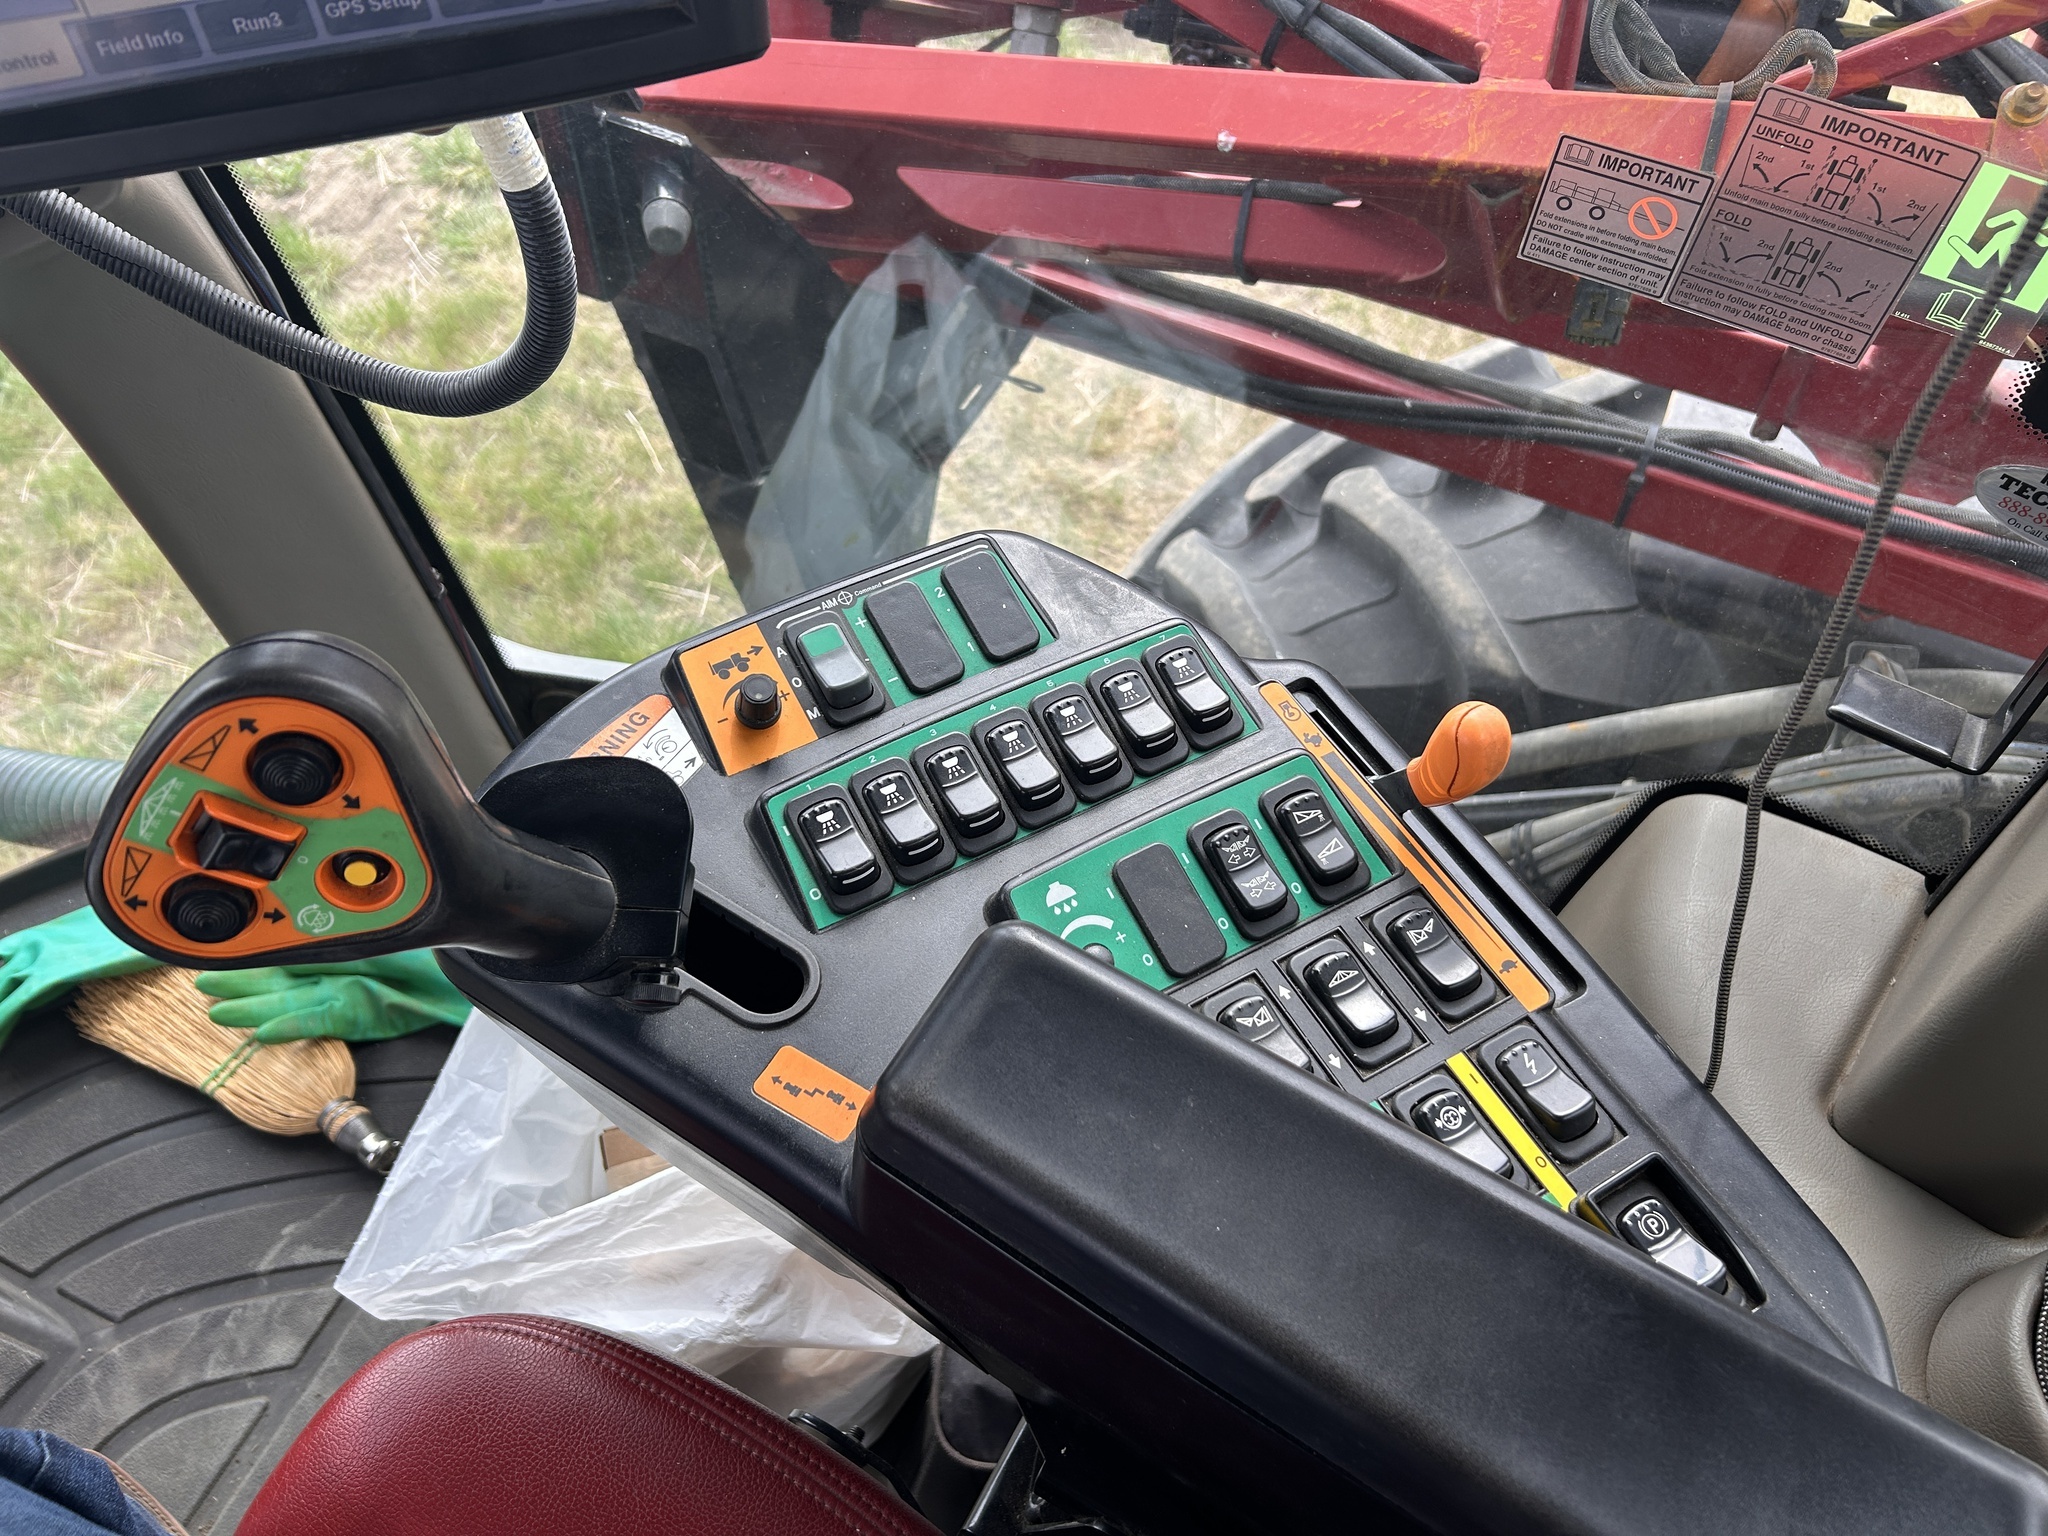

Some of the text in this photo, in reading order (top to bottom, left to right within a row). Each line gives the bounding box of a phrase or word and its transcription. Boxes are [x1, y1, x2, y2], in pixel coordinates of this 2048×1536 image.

[324, 0, 365, 19] GPS
[231, 11, 283, 35] Run3
[95, 29, 184, 57] Field Info
[0, 49, 59, 73] ontrol
[1756, 124, 1814, 150] UNFOLD
[1820, 114, 1950, 166] IMPORTANT
[1755, 151, 1775, 163] 2nd
[1800, 159, 1815, 171] 1st
[1597, 153, 1700, 194] IMPORTANT
[1872, 182, 1887, 194] 1st
[1906, 199, 1927, 212] 2nd
[1715, 208, 1752, 227] FOLD
[1724, 188, 1914, 256] Unfold main boom fully before unfolding extension.
[1536, 219, 1668, 264] DO NOT cradle with extensions unfolded.
[1540, 210, 1676, 256] Fold extensions in before folding main boom.
[1719, 232, 1732, 242] 1st
[1756, 240, 1776, 251] 2nd
[1530, 242, 1568, 260] DAMAGE
[1568, 256, 1596, 269] center
[1597, 264, 1628, 278] section
[1640, 278, 1658, 288] unit.
[1532, 234, 1666, 282] Failure to follow instruction may
[1824, 261, 1844, 273] 2nd
[1864, 280, 1879, 291] 1st
[1689, 264, 1872, 331] Fold extension in fully before folding main boom.
[1680, 278, 1854, 342] Failure to follow FOLD and UNFOLD
[1674, 288, 1858, 356] instruction may DAMAGE boom or chassis.
[1999, 473, 2048, 510] TEC
[2007, 517, 2022, 529] On
[2023, 524, 2041, 539] Call
[820, 582, 882, 610] AIM Command
[934, 586, 946, 598] 2
[967, 642, 974, 652] 1
[1158, 634, 1166, 642] 7
[776, 646, 788, 659] A
[1103, 657, 1111, 665] 6
[1046, 680, 1054, 688] 5
[806, 706, 821, 720] M
[989, 704, 996, 712] 4
[930, 728, 938, 736] 3
[868, 755, 877, 764] 2
